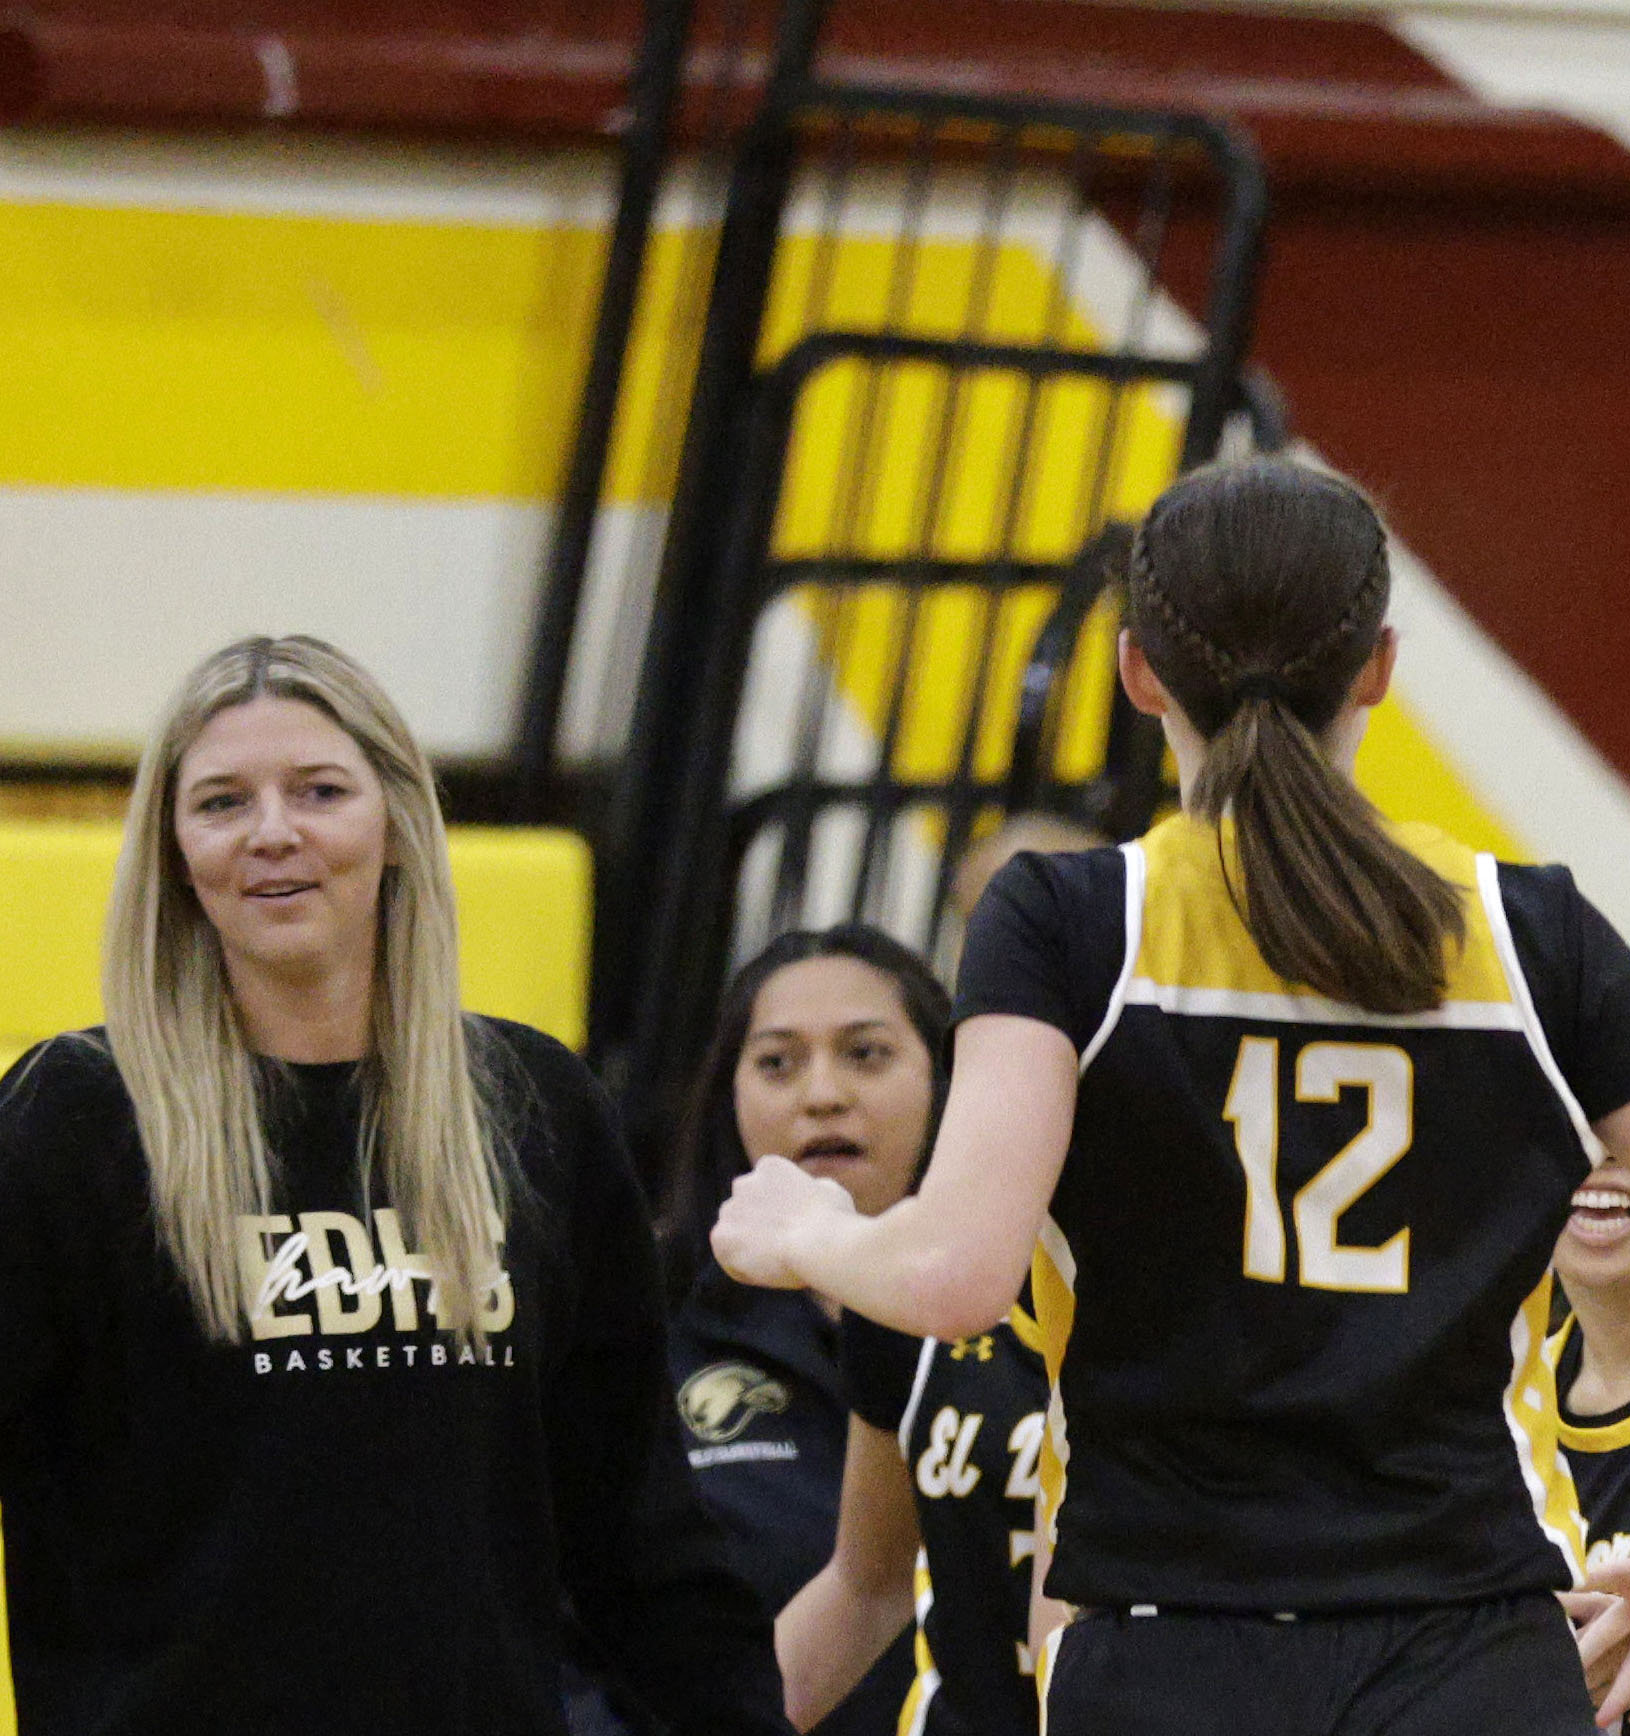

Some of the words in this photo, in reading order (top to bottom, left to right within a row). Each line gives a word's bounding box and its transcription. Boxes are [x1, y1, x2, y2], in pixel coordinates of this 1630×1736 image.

[1222, 1034, 1415, 1294] 12
[254, 1345, 514, 1375] BASKETBALL
[916, 1405, 983, 1498] El
